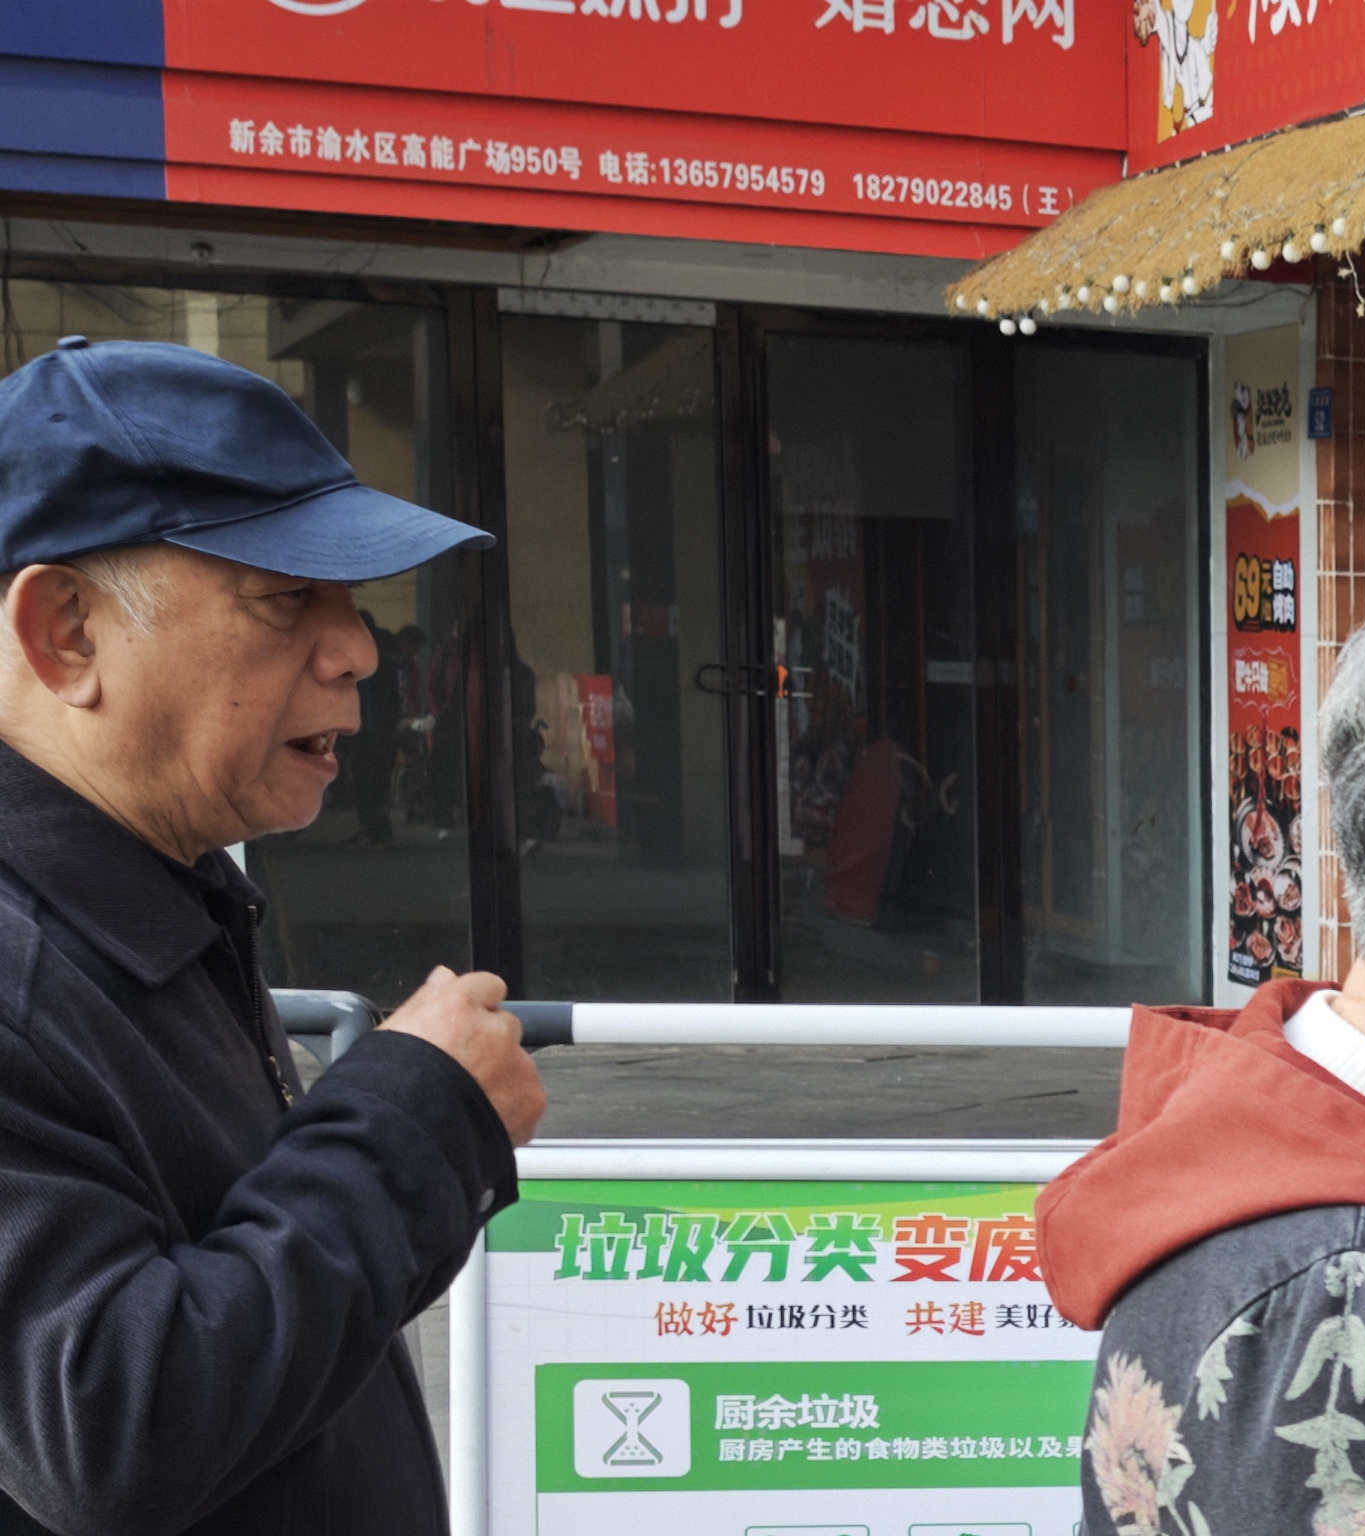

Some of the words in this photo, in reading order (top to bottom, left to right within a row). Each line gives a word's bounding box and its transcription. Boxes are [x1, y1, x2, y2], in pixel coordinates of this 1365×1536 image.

[228, 118, 583, 180] 新余市渝水区高能广场950号
[598, 149, 826, 197] 电话:13657954579
[553, 1211, 1046, 1283] 垃圾分类变废
[714, 1393, 881, 1430] 厨余垃圾
